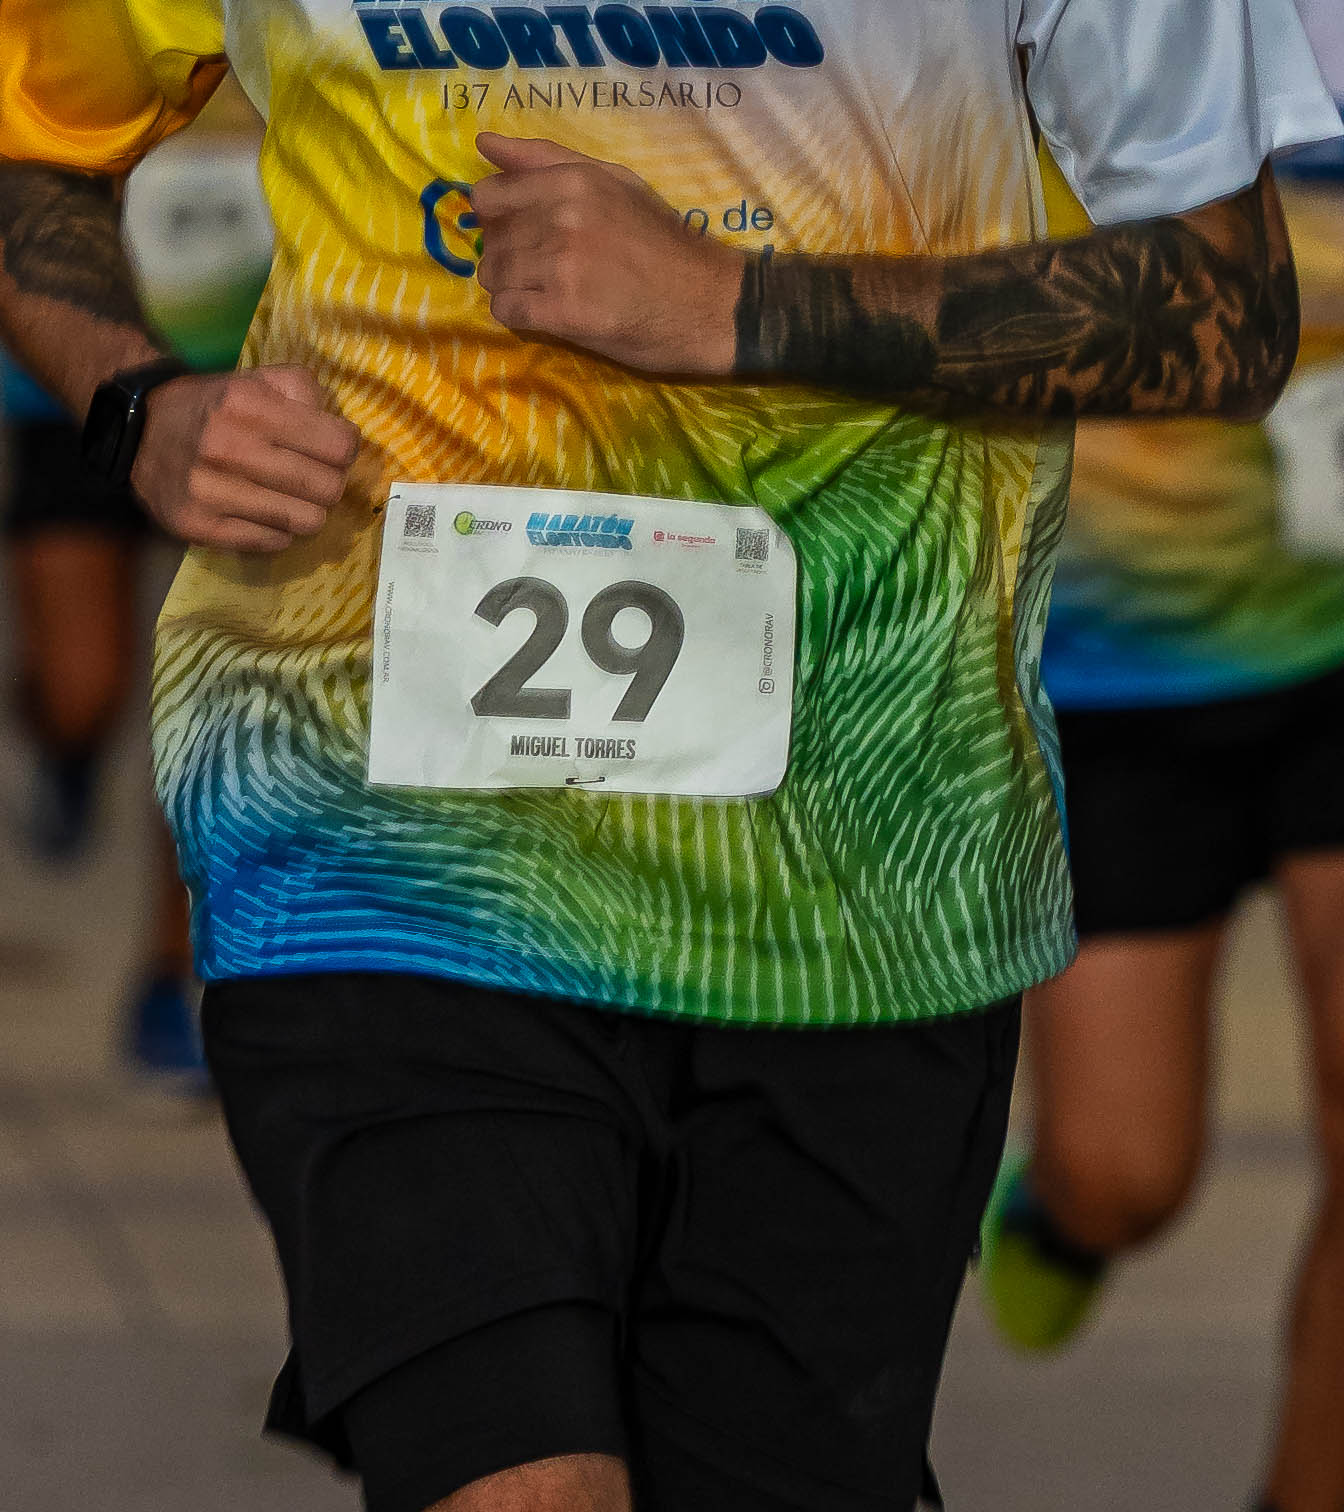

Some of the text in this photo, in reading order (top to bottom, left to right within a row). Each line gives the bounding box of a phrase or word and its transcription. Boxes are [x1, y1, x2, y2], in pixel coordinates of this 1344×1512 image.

[356, 4, 824, 70] ELORTONDO
[443, 81, 742, 113] 137 ANIVERSARIO
[722, 199, 774, 232] de
[470, 576, 685, 723] 29
[511, 735, 636, 760] MIGUEL TORRES
